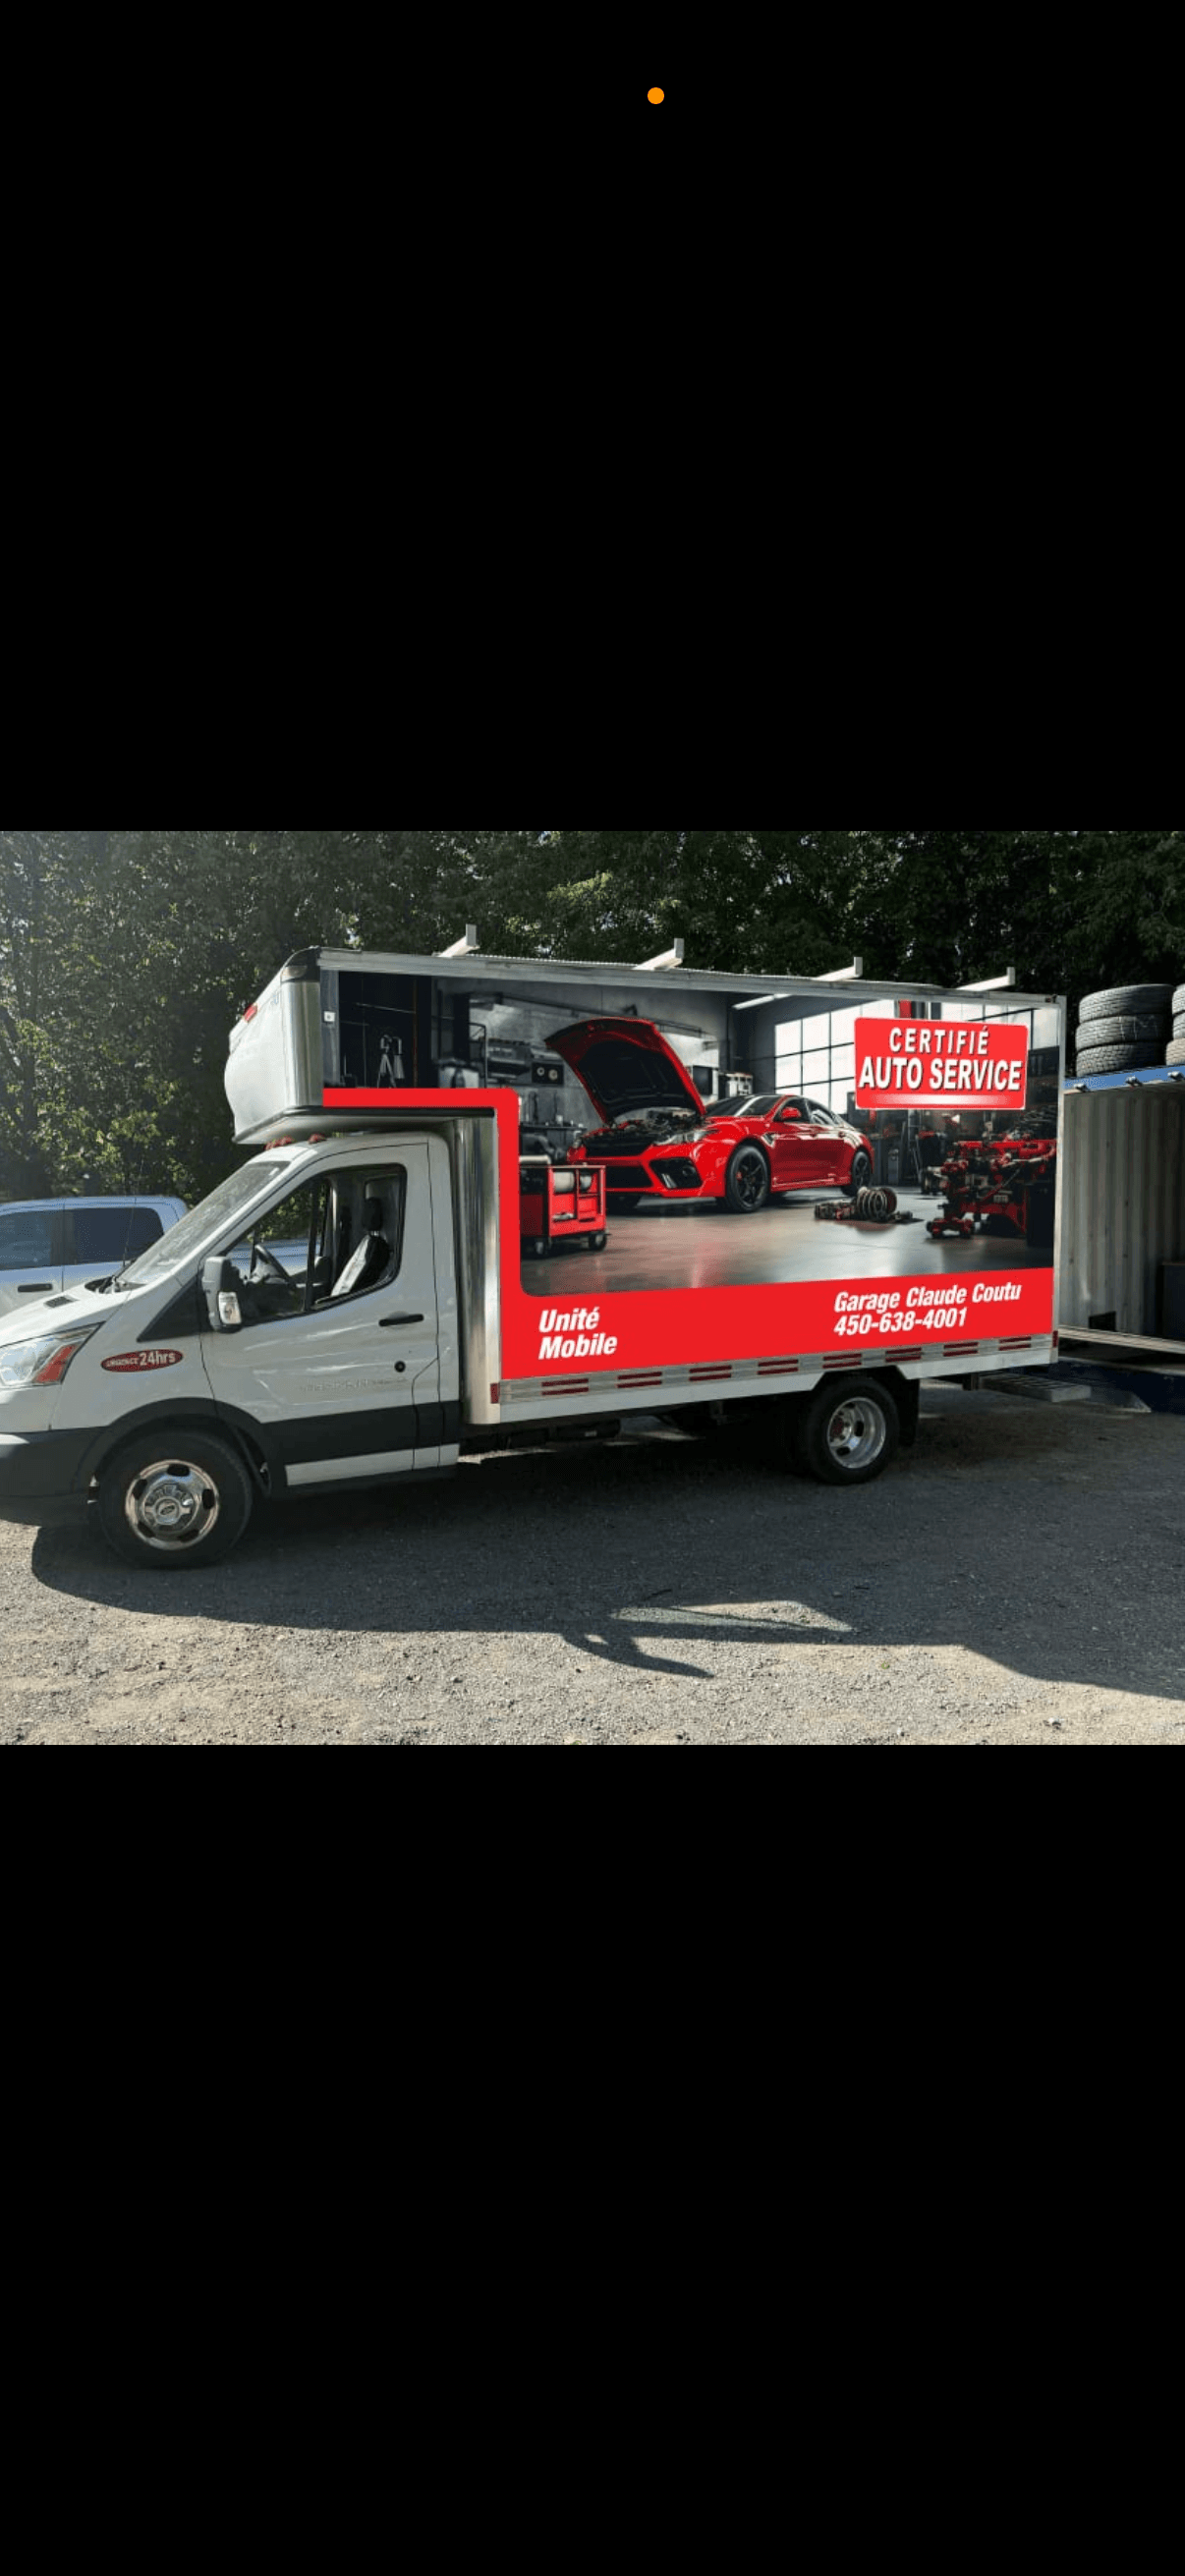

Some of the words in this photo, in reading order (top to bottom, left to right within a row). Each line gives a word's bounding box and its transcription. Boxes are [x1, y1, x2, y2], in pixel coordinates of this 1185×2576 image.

[889, 1025, 989, 1054] CERTIFIÉ
[858, 1056, 923, 1090] AUTO
[929, 1058, 1022, 1091] SERVICE
[833, 1291, 900, 1314] Garage
[905, 1284, 967, 1308] Claude
[972, 1282, 1022, 1304] Coutu
[538, 1306, 600, 1333] Unité
[833, 1307, 968, 1336] 450-638-4001
[140, 1351, 176, 1367] 24hrs
[537, 1332, 618, 1360] Mobile
